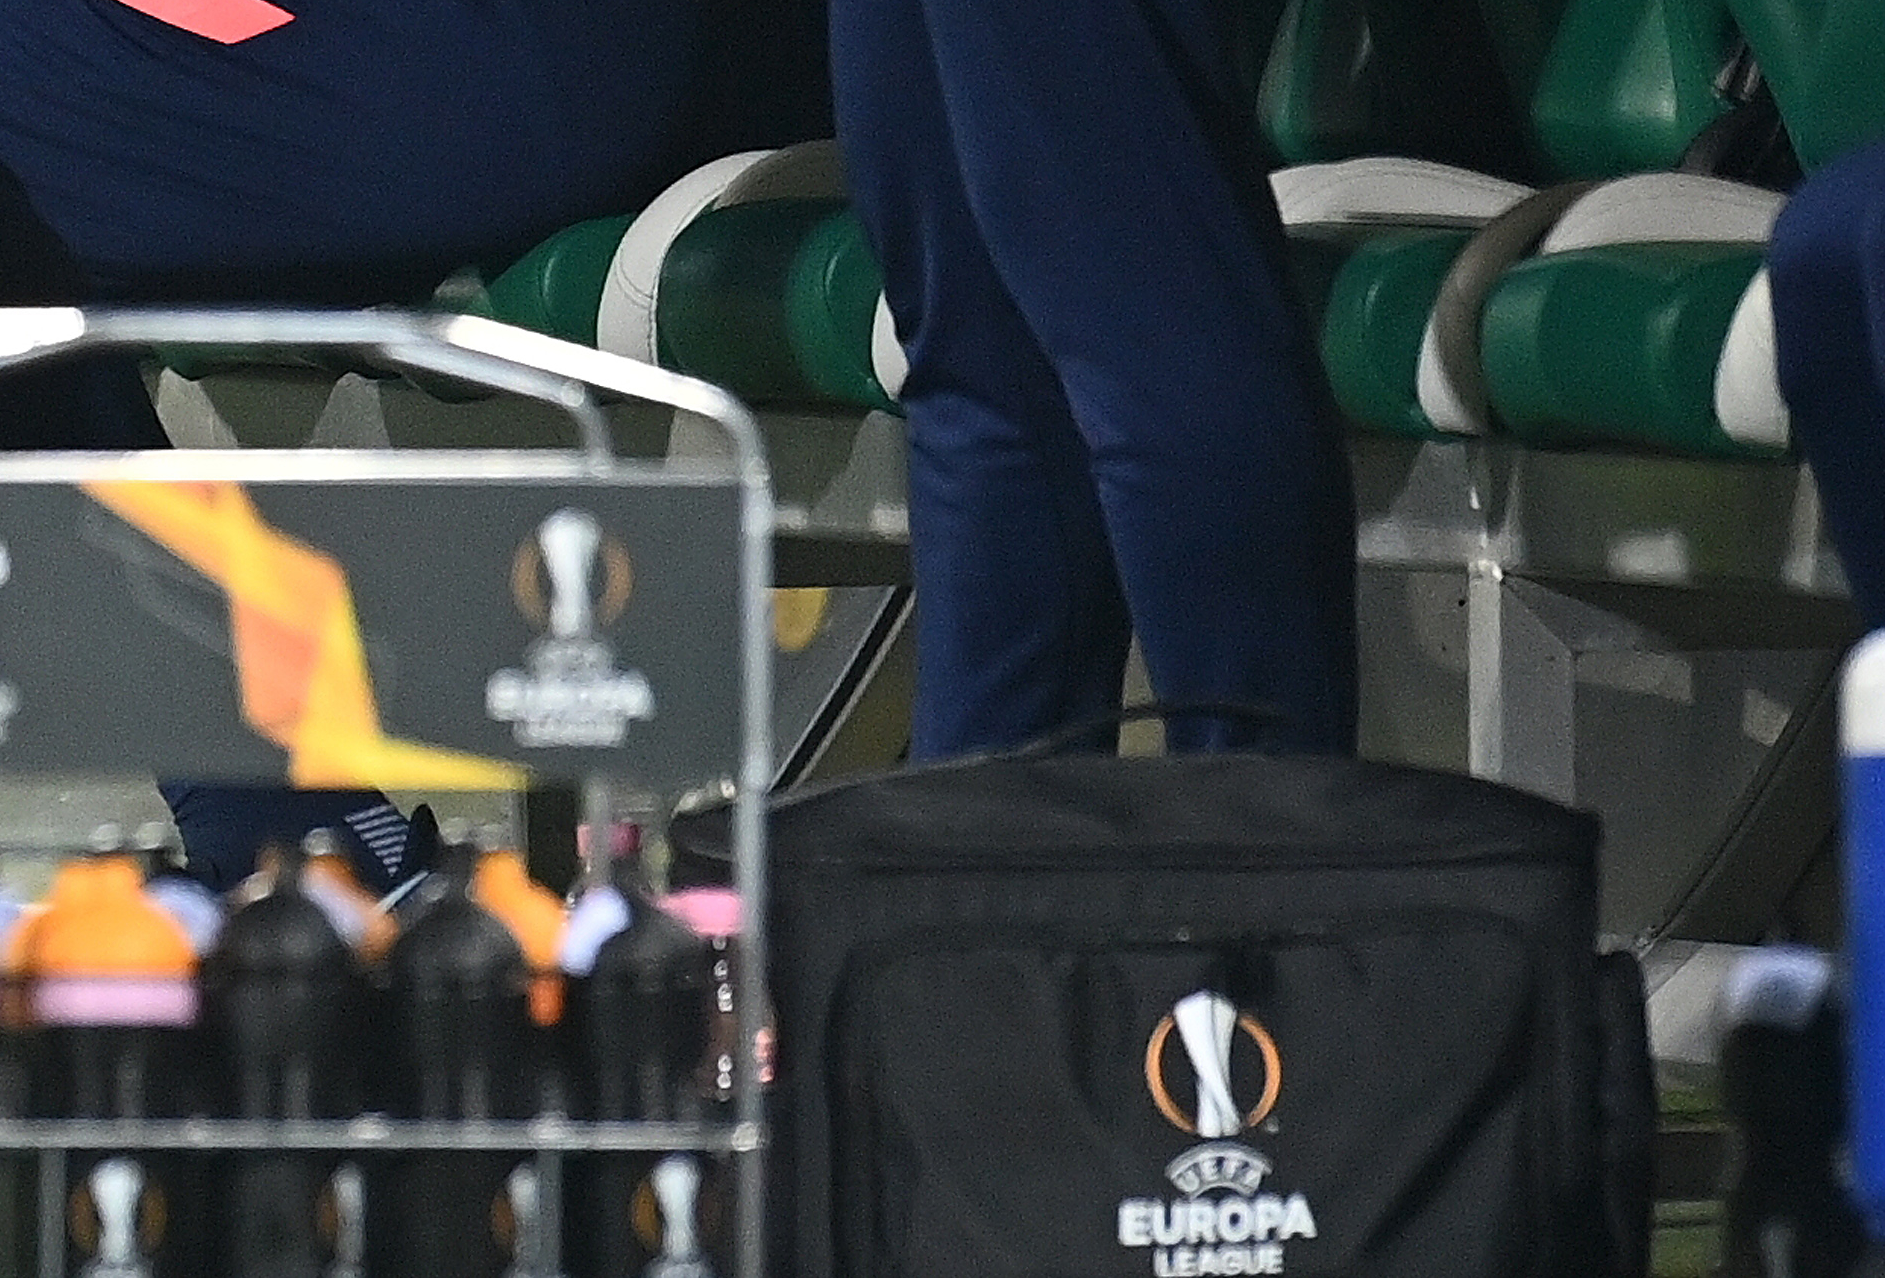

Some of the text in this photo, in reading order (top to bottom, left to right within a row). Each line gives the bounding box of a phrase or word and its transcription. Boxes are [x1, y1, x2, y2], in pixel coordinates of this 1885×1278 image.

[1170, 1145, 1268, 1196] UEFA
[1117, 1192, 1318, 1247] EUROPA
[1152, 1243, 1284, 1278] LEAGUE
